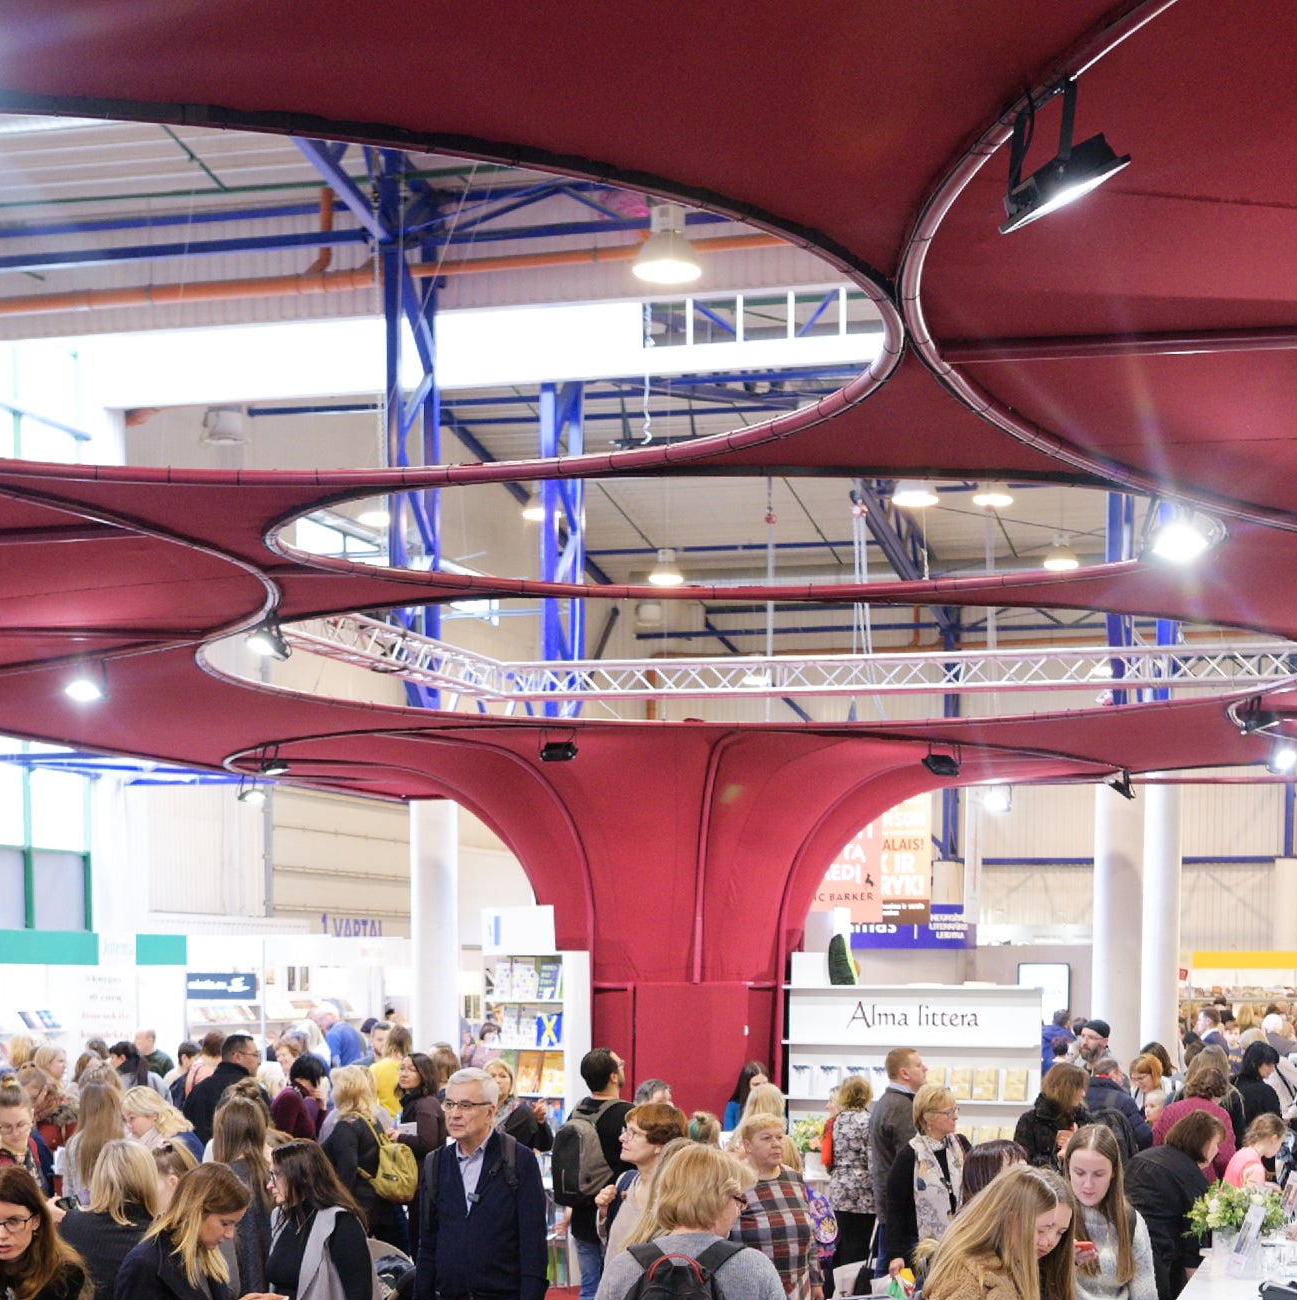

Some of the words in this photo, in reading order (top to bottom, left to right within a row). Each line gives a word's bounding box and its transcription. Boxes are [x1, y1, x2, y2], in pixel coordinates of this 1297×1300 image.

[895, 853, 915, 873] IR
[830, 892, 873, 902] BARKER
[846, 1000, 910, 1029] Alma
[918, 1003, 979, 1027] littera
